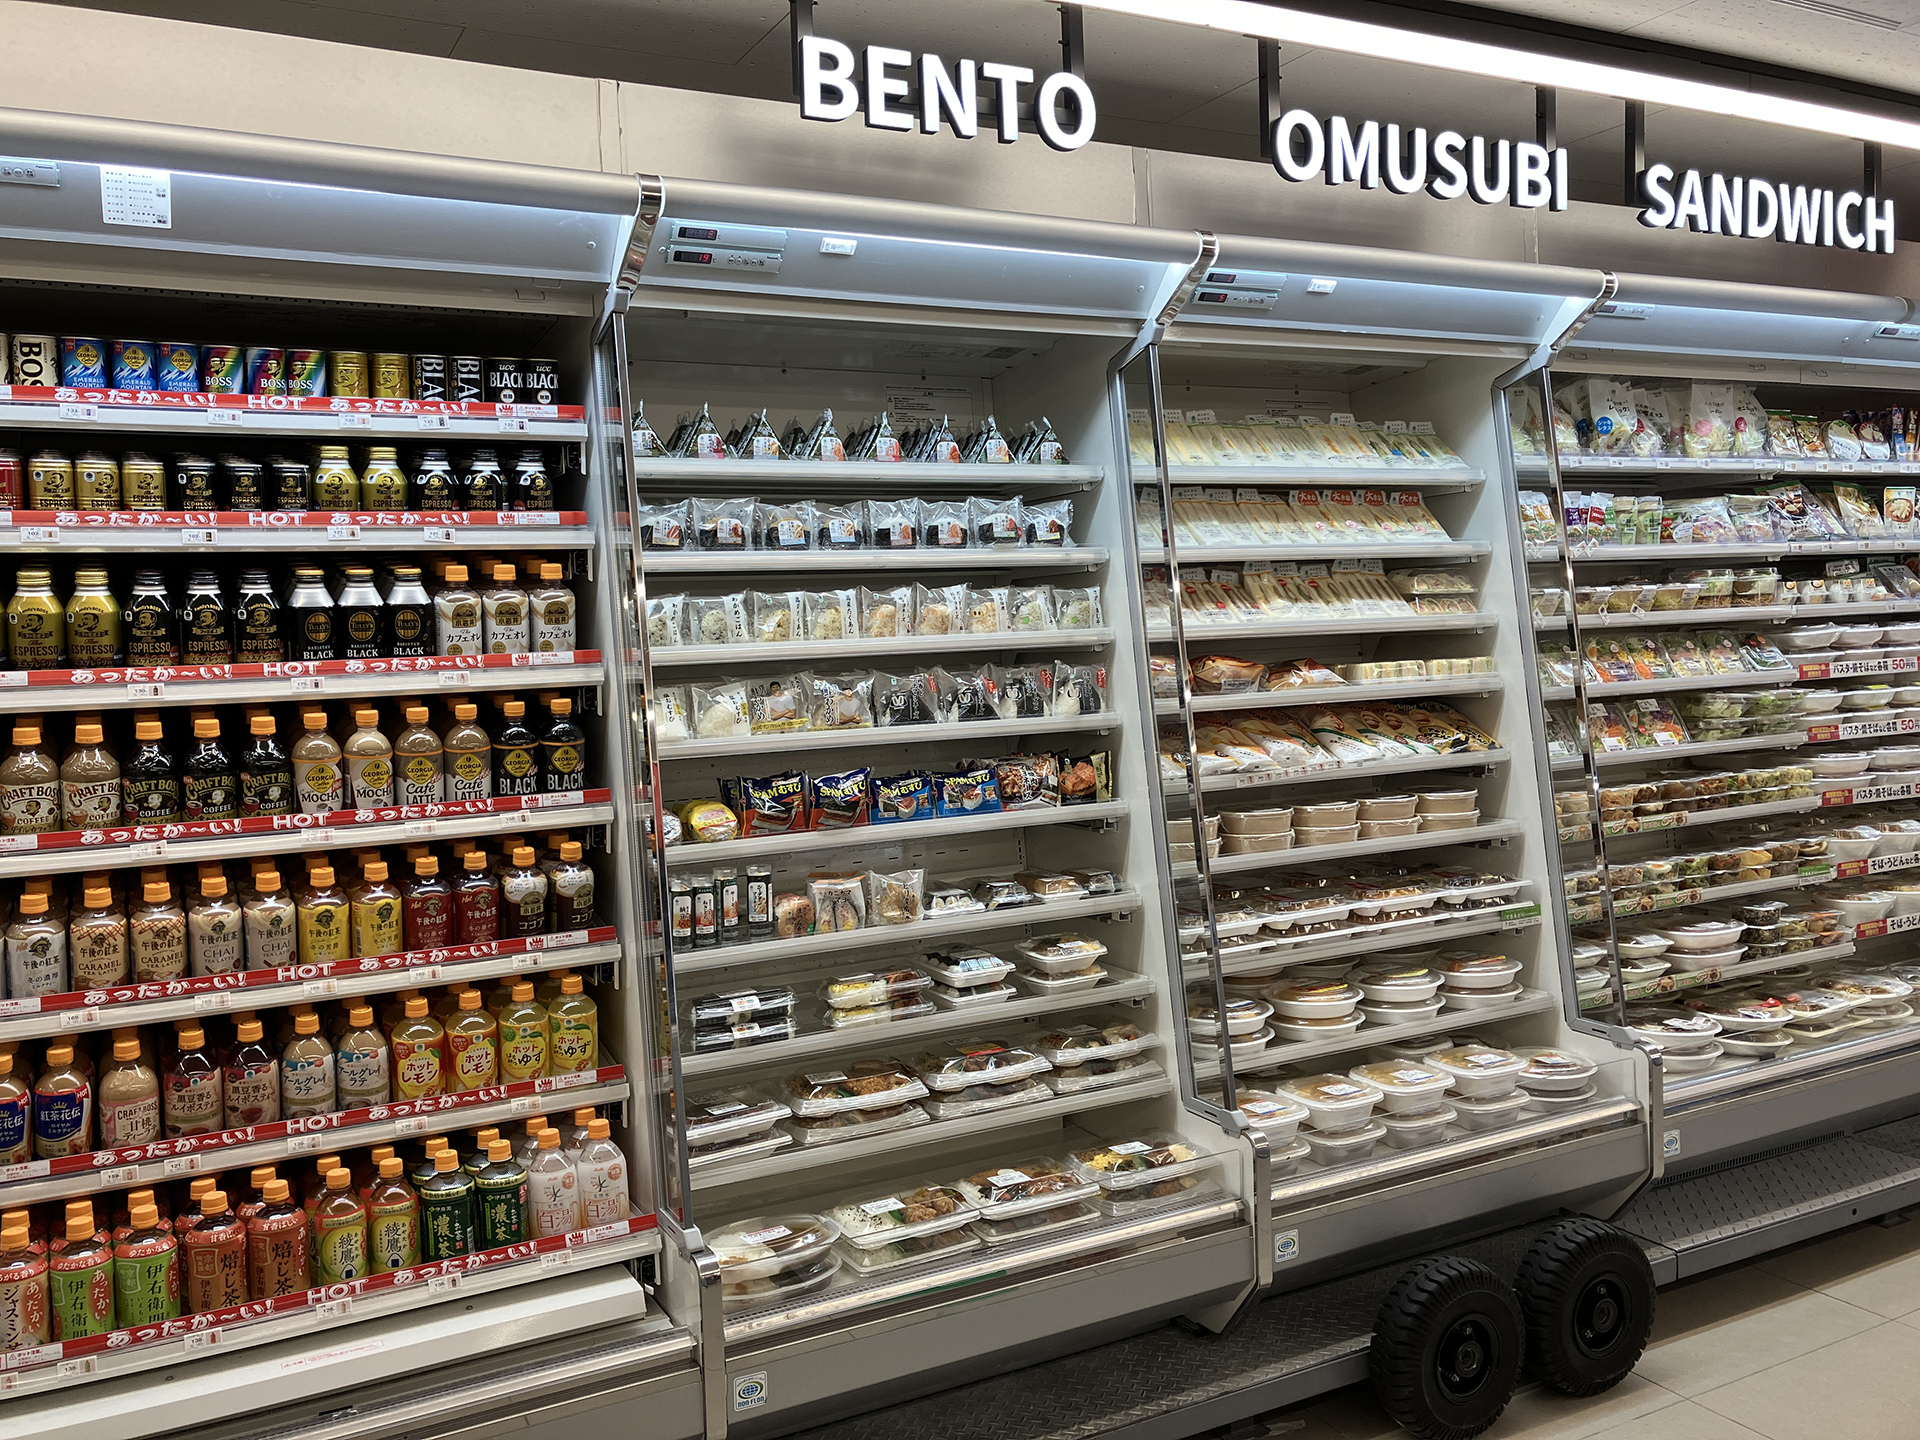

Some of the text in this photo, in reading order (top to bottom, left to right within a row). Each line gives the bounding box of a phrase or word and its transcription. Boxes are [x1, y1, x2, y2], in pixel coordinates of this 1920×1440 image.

[799, 35, 1096, 151] BENTO
[1274, 109, 1568, 211] OMUSUBI
[1638, 163, 1894, 254] SANDWICH
[74, 376, 104, 384] EMERALD
[205, 376, 232, 386] BOSS
[260, 378, 286, 388] BOSS
[289, 379, 313, 389] BOSS
[490, 371, 523, 388] BLACK
[526, 373, 559, 389] BLACK
[247, 395, 307, 410] HOT
[321, 500, 353, 508] ESPRESSO
[373, 500, 404, 508] ESPRESSO
[422, 500, 452, 508] ESPRESSO
[467, 500, 497, 508] ESPRESSO
[248, 512, 308, 526] HOT
[455, 619, 475, 627] 小岩井
[498, 617, 519, 625] 小岩井
[546, 616, 567, 624] 小岩井
[732, 596, 743, 638] わかめごはん
[446, 633, 481, 643] カフェオレ
[491, 631, 527, 640] カフェオレ
[538, 630, 574, 639] カフェオレ
[14, 645, 59, 656] ESPRESSO
[71, 644, 115, 655] ESPRESSO
[129, 641, 171, 653] ESPRESSO
[188, 640, 229, 651] ESPRESSO
[242, 638, 281, 650] ESPRESSO
[303, 650, 334, 660] BLACK
[347, 649, 379, 657] BLACK
[393, 647, 424, 656] BLACK
[263, 661, 322, 677] HOT
[554, 755, 578, 763] GEORGIA
[243, 773, 276, 796] CRAFT
[307, 774, 335, 782] GEORGIA
[547, 772, 584, 790] BLACK
[123, 779, 158, 803] CRAFT
[185, 776, 221, 799] CRAFT
[500, 776, 537, 795] BLACK
[69, 782, 106, 808] CRAFT
[301, 791, 340, 803] MOCHA
[406, 794, 436, 805] LATTE
[455, 789, 484, 800] LATTE
[203, 803, 232, 813] COFFEE
[260, 799, 288, 810] COFFEE
[89, 812, 118, 821] COFFEE
[139, 808, 171, 817] COFFEE
[17, 815, 50, 825] COFFEE
[273, 811, 331, 830] HOT
[411, 901, 422, 909] Hot
[462, 895, 473, 903] Hot
[576, 897, 593, 908] 小岩井
[466, 906, 497, 920] 午後の紅茶
[523, 905, 543, 914] 小岩井
[416, 913, 448, 926] 午後の紅茶
[518, 916, 545, 930] ココア
[199, 930, 238, 945] 午後の紅茶
[257, 925, 293, 940] 午後の紅茶
[308, 926, 341, 938] 午後の紅茶
[141, 935, 183, 952] 午後の紅茶
[261, 939, 292, 953] CHAI
[79, 944, 120, 959] 午後の紅茶
[141, 951, 184, 965] CARAMEL
[203, 945, 235, 959] CHAI
[23, 955, 60, 970] 午後の紅茶
[78, 959, 121, 971] CARAMEL
[161, 958, 182, 968] LATTE
[217, 955, 234, 963] LATTE
[98, 967, 118, 975] LATTE
[277, 962, 336, 982] HOT
[27, 972, 59, 984] 冬の濃厚
[557, 1035, 584, 1045] ホット
[512, 1043, 539, 1054] ホット
[564, 1040, 592, 1058] ゆず
[465, 1050, 492, 1064] ホット
[518, 1048, 544, 1067] ゆず
[337, 1065, 382, 1078] アールグレイ
[406, 1060, 435, 1072] ホット
[461, 1057, 495, 1075] レモン
[282, 1073, 327, 1087] アールグレイ
[349, 1077, 368, 1087] ラテ
[401, 1069, 439, 1084] レモン
[77, 1088, 89, 1099] HOT
[231, 1084, 268, 1095] 黒豆香る
[294, 1086, 313, 1096] ラテ
[18, 1094, 29, 1107] HOT
[176, 1092, 212, 1104] 黒豆香る
[226, 1091, 276, 1105] ルイボスティー
[170, 1100, 218, 1113] ルイボスティー
[40, 1106, 81, 1122] 紅茶花伝
[117, 1106, 140, 1121] CRAFT
[51, 1121, 71, 1129] ロイヤル
[129, 1116, 152, 1133] 甘桃
[286, 1112, 345, 1134] HOT
[48, 1126, 75, 1134] ミルクティー
[587, 1198, 618, 1218] 白湯
[262, 1218, 299, 1231] 甘香ばしい
[491, 1202, 511, 1241] 濃い茶
[540, 1208, 572, 1229] 白湯
[384, 1221, 402, 1254] 綾鷹
[433, 1214, 456, 1258] 濃い茶
[338, 1232, 356, 1266] 綾鷹
[57, 1256, 101, 1270] ゆたかな香り
[271, 1240, 294, 1296] 焙じ茶
[168, 1252, 180, 1303] あったかい
[220, 1250, 241, 1308] 焙じ茶
[93, 1269, 110, 1320] あったかい
[307, 1278, 368, 1305] HOT
[26, 1281, 43, 1333] あったかい
